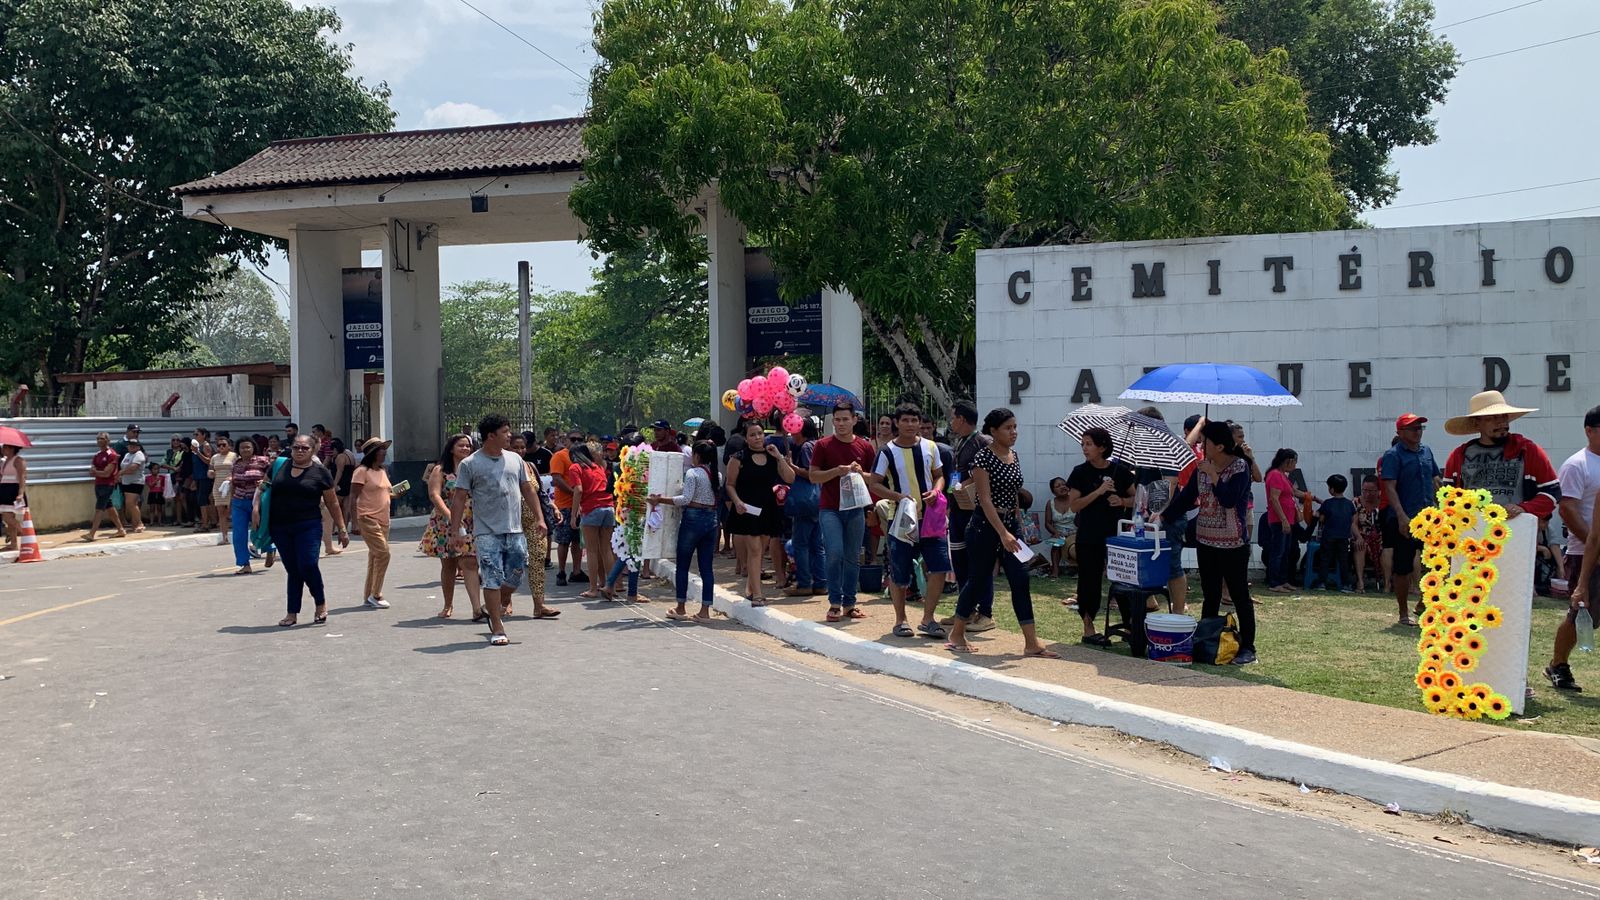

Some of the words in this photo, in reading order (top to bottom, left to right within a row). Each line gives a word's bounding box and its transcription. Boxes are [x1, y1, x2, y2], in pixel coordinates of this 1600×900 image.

[1008, 245, 1574, 304] CEMITÉRIO
[751, 315, 788, 323] PERPÉTUOS
[1009, 361, 1372, 405] PAUE
[1482, 354, 1571, 392] DE
